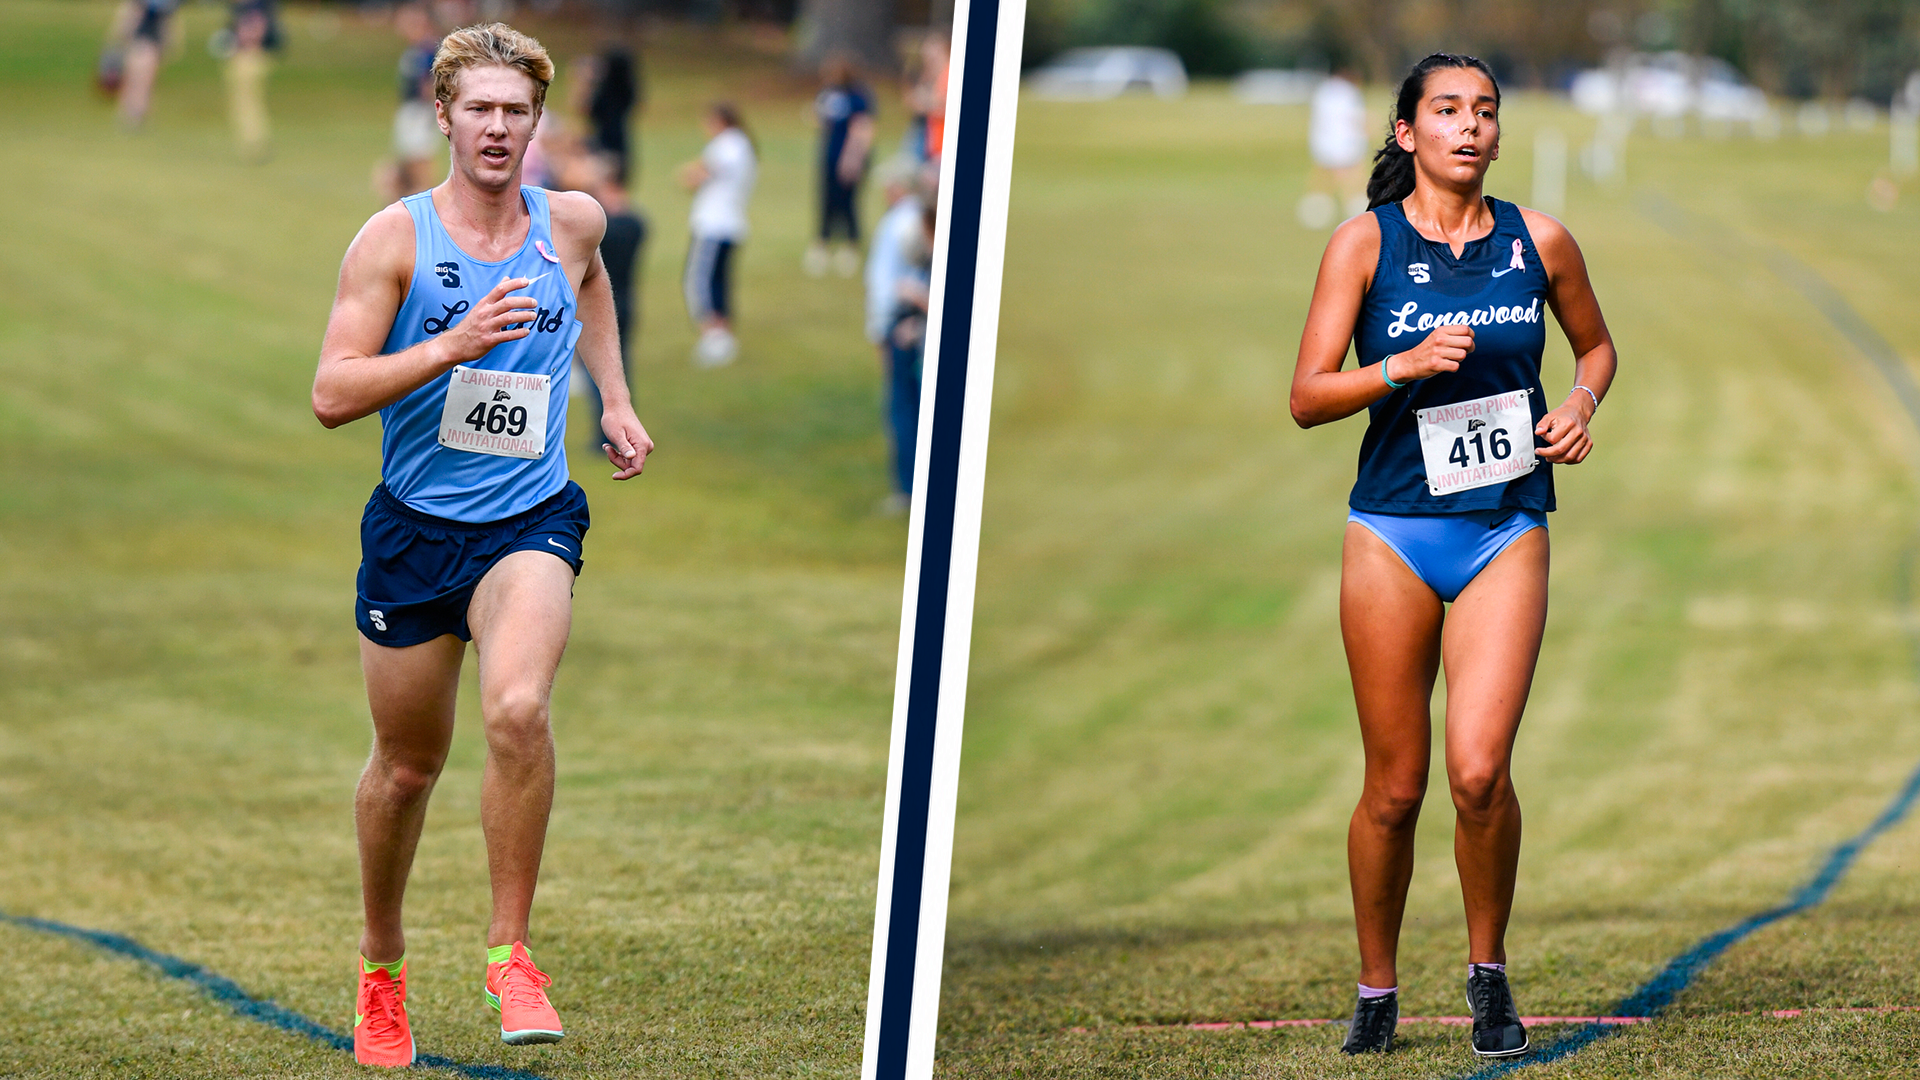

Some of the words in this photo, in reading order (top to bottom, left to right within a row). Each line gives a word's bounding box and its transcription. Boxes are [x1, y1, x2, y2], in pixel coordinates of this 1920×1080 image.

[435, 266, 448, 274] BIG
[461, 371, 512, 388] LANCER
[515, 376, 544, 391] PINK
[465, 402, 527, 436] 469
[1427, 403, 1482, 424] LANCER
[1486, 395, 1518, 413] PINK
[447, 428, 535, 453] INVITATIONAL
[1449, 428, 1511, 468] 416
[1437, 457, 1527, 488] INVITATIONAL
